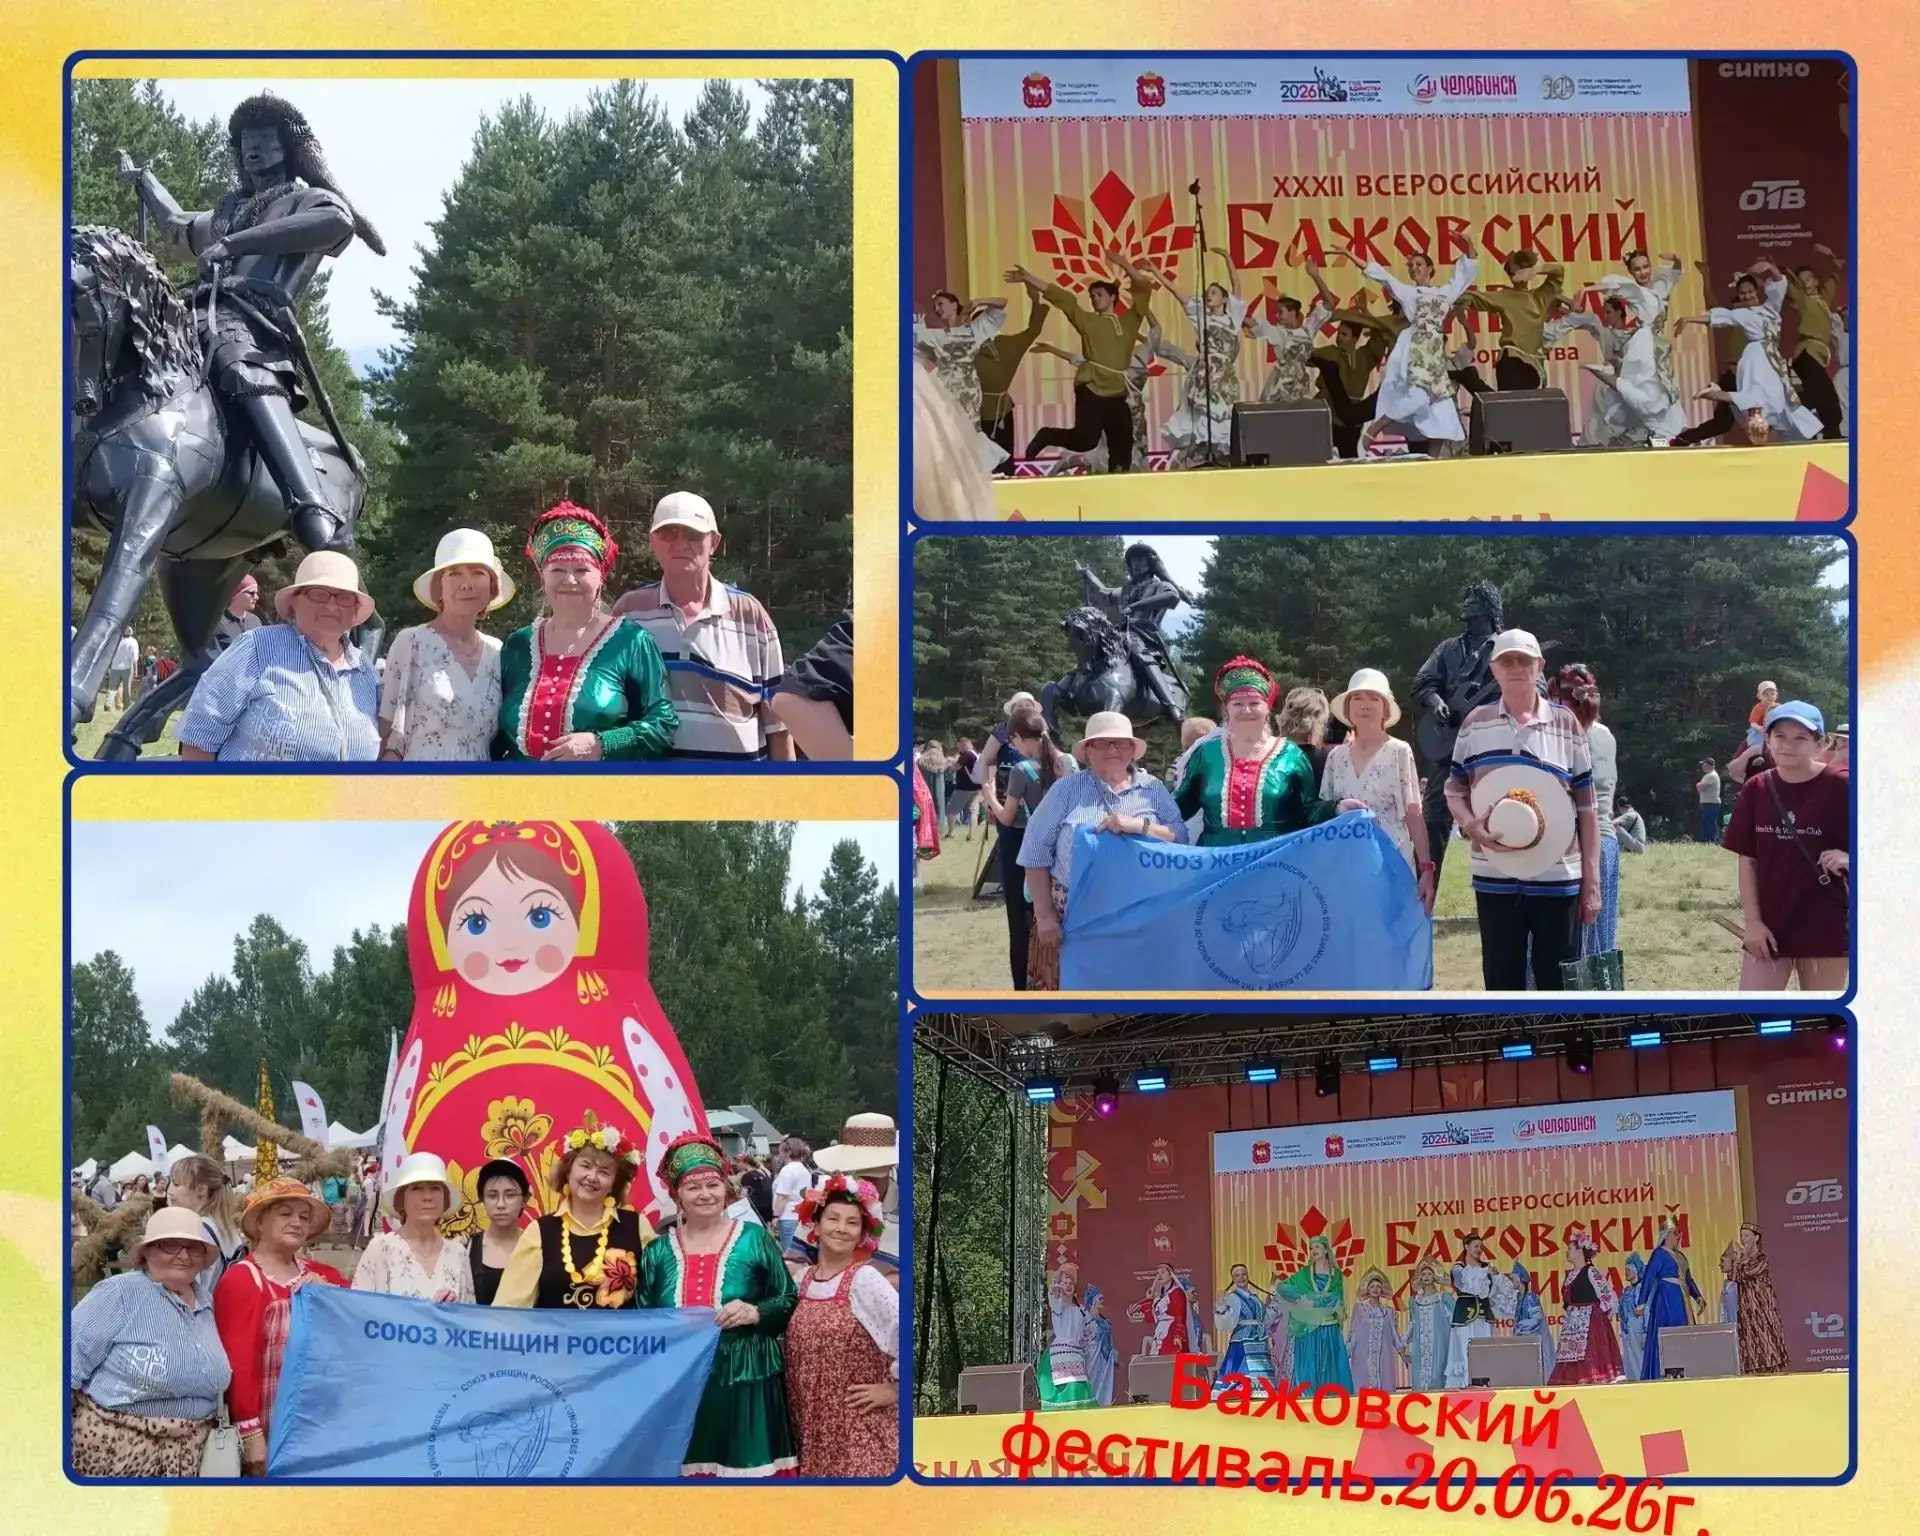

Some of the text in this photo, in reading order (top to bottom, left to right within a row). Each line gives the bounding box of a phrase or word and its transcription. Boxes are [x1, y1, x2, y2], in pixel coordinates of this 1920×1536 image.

[1280, 84, 1317, 99] 2026
[1440, 75, 1517, 96] ЧЕЛЯБИНСК
[1273, 166, 1602, 198] XXXII ВСЕРОССИЙСКИЙ
[1806, 826, 1822, 836] Club
[1139, 851, 1204, 870] СОЮЗ
[1537, 1115, 1597, 1134] ЧЕЛЯБИНСК
[1421, 1134, 1448, 1145] 2026
[1416, 1183, 1655, 1217] XXXII ВСЕРОССИЙСКИЙ
[363, 1319, 667, 1357] СОЮЗ ЖЕНЩИН РОССИИ
[460, 1369, 562, 1397] СОЮЗ ЖЕНЩИН РОССИИ
[431, 1403, 451, 1431] RUSSIA
[569, 1437, 580, 1455] DES
